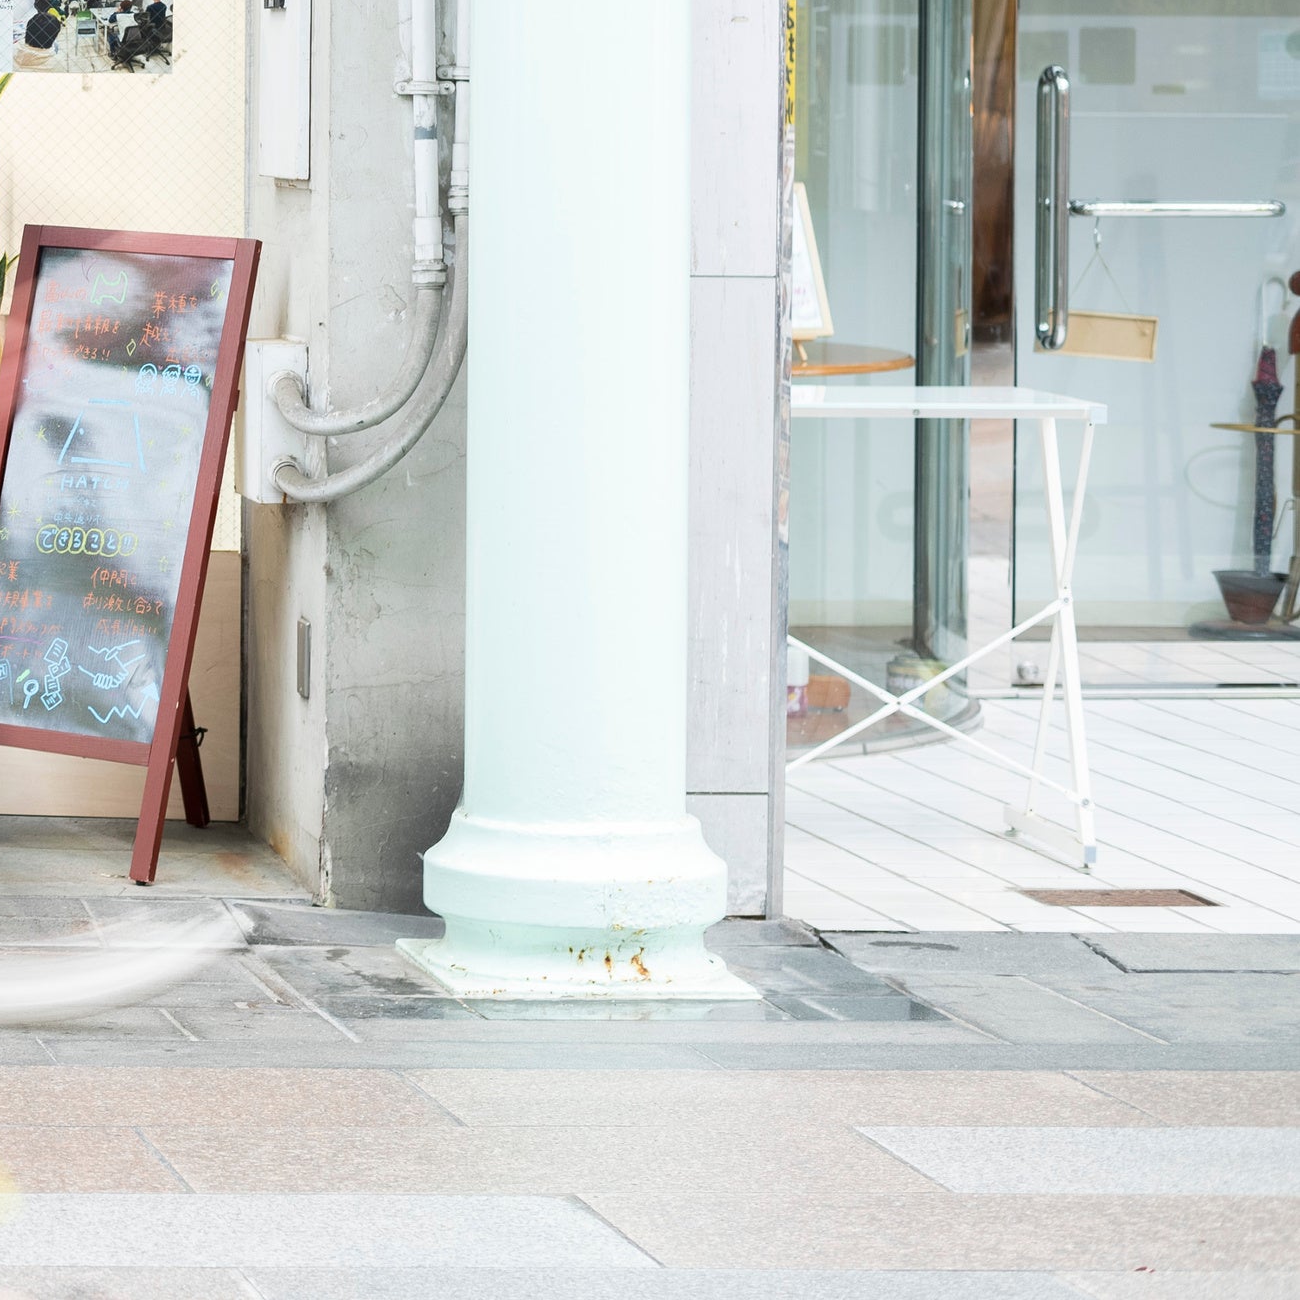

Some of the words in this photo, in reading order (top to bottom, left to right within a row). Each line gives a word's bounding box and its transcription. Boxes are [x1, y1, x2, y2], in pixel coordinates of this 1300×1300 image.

[60, 473, 130, 491] HATCH
[90, 565, 137, 588] 仲間と
[81, 592, 164, 616] 刺激し合って
